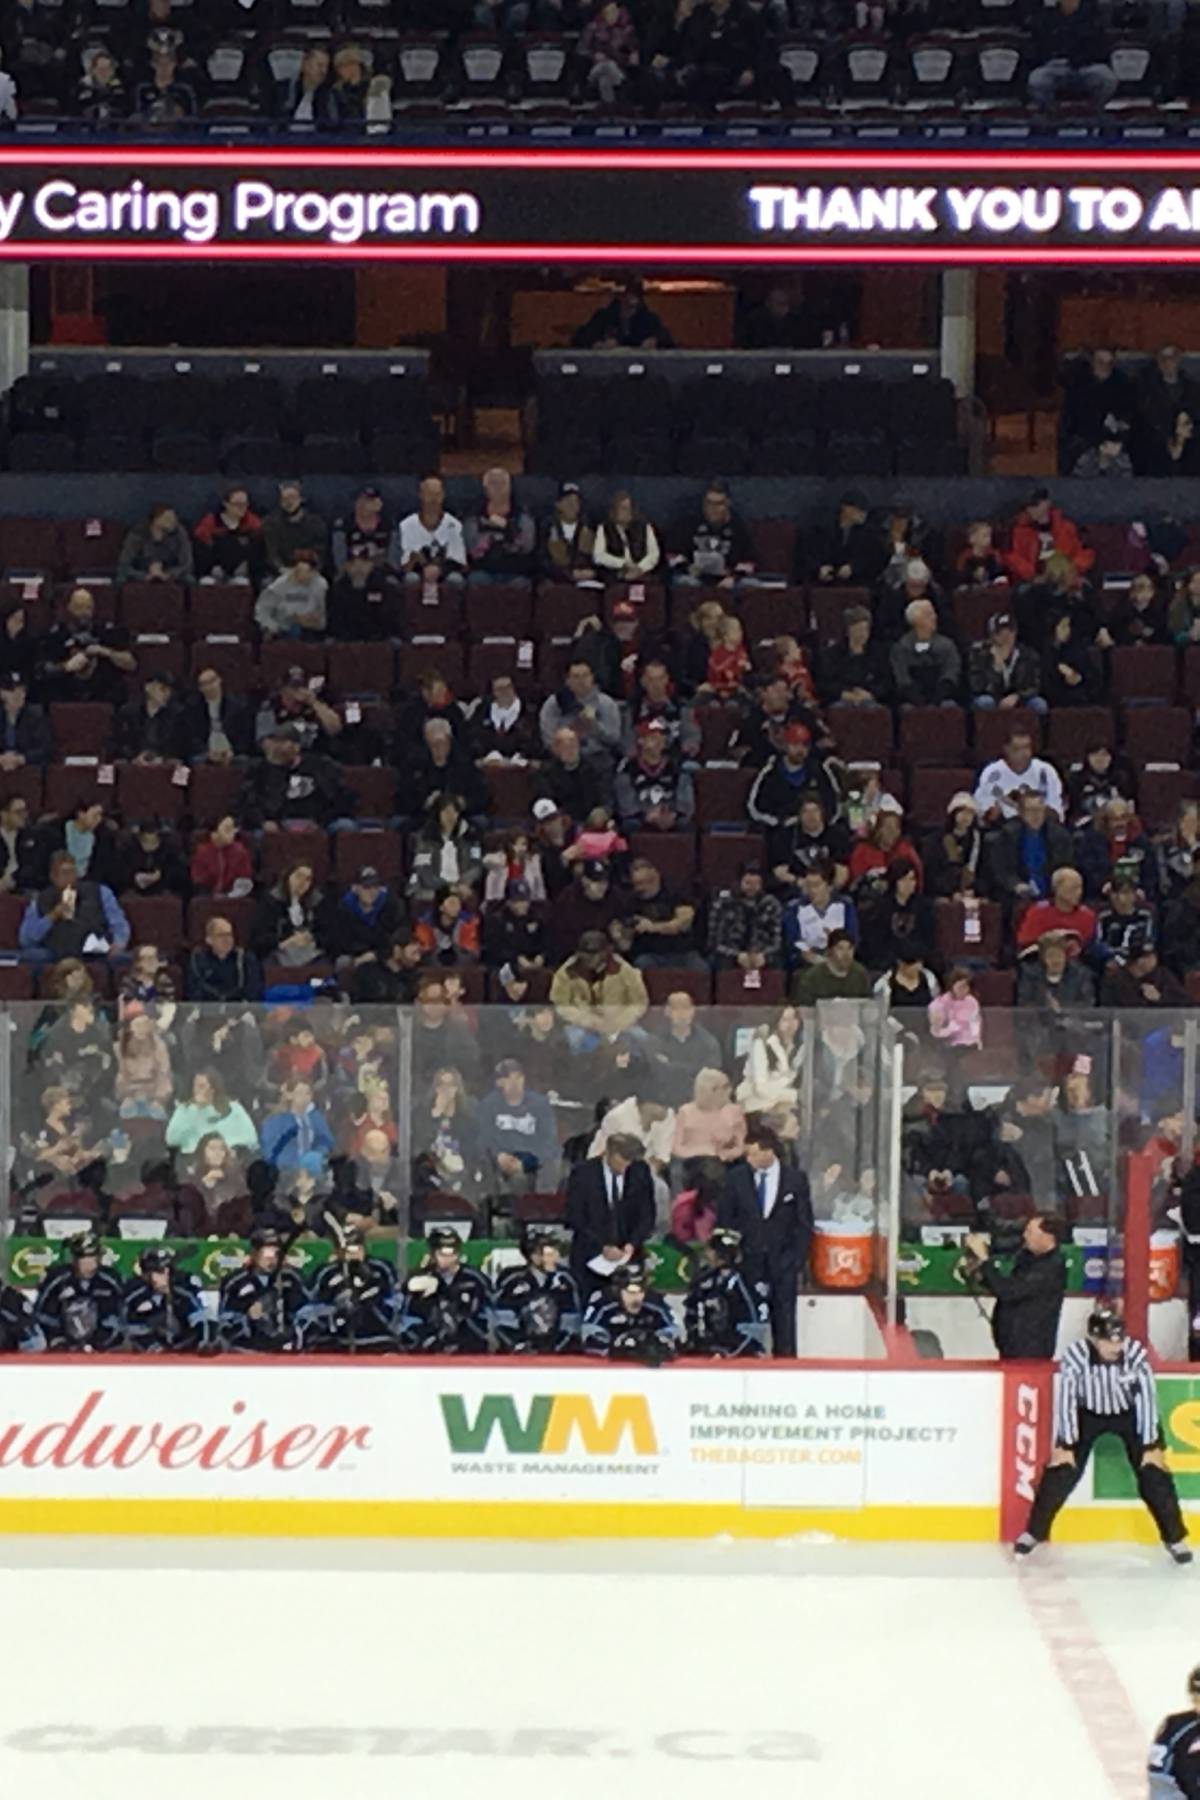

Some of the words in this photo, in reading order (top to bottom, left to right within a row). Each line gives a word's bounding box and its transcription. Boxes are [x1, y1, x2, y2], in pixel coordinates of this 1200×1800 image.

[34, 180, 218, 241] Caring
[235, 180, 479, 242] Program
[749, 187, 938, 231] THANK
[946, 187, 1061, 231] YOU
[1068, 187, 1142, 231] TO
[438, 1394, 659, 1456] WM
[689, 1403, 799, 1420] PLANNING
[804, 1404, 819, 1420] A
[825, 1404, 887, 1421] HOME
[689, 1425, 845, 1441] IMPROVEMENT
[849, 1426, 958, 1443] PROJECT?
[1014, 1383, 1040, 1503] CCM
[451, 1462, 517, 1475] WASTE
[522, 1462, 660, 1475] MANAGEMENT
[689, 1448, 863, 1465] THEBAGSTER.COM
[3, 1724, 822, 1761] CARSTAR.ca
